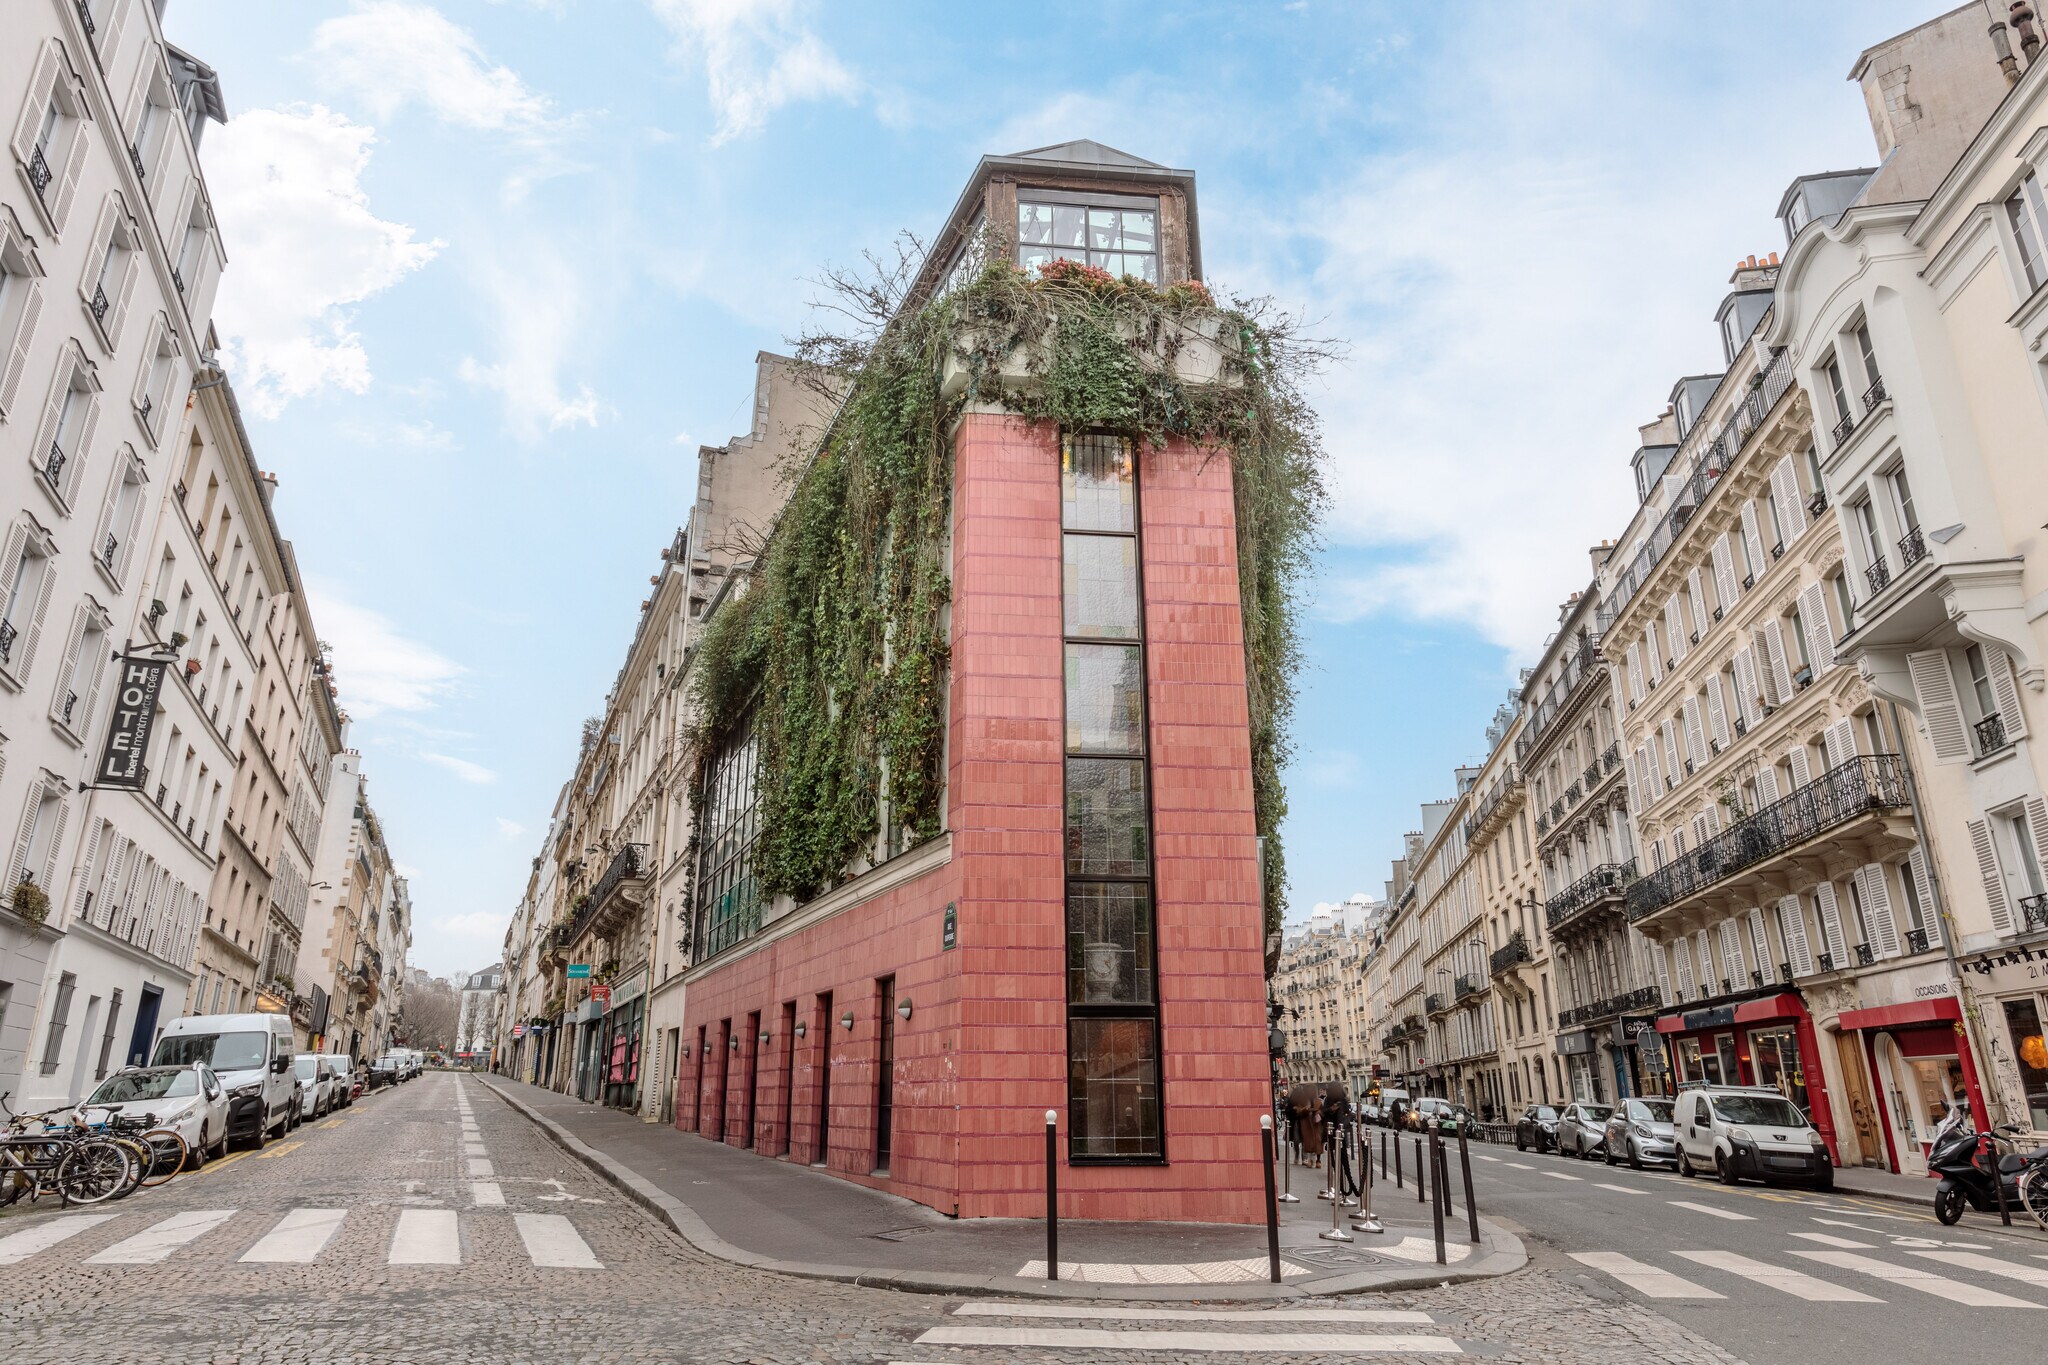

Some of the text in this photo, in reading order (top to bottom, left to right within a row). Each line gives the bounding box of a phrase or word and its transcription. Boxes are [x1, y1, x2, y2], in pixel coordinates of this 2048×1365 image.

[106, 665, 149, 777] HOTEL
[124, 747, 141, 778] libertel
[146, 667, 160, 693] opéra
[1915, 983, 1948, 998] OCCASIONS
